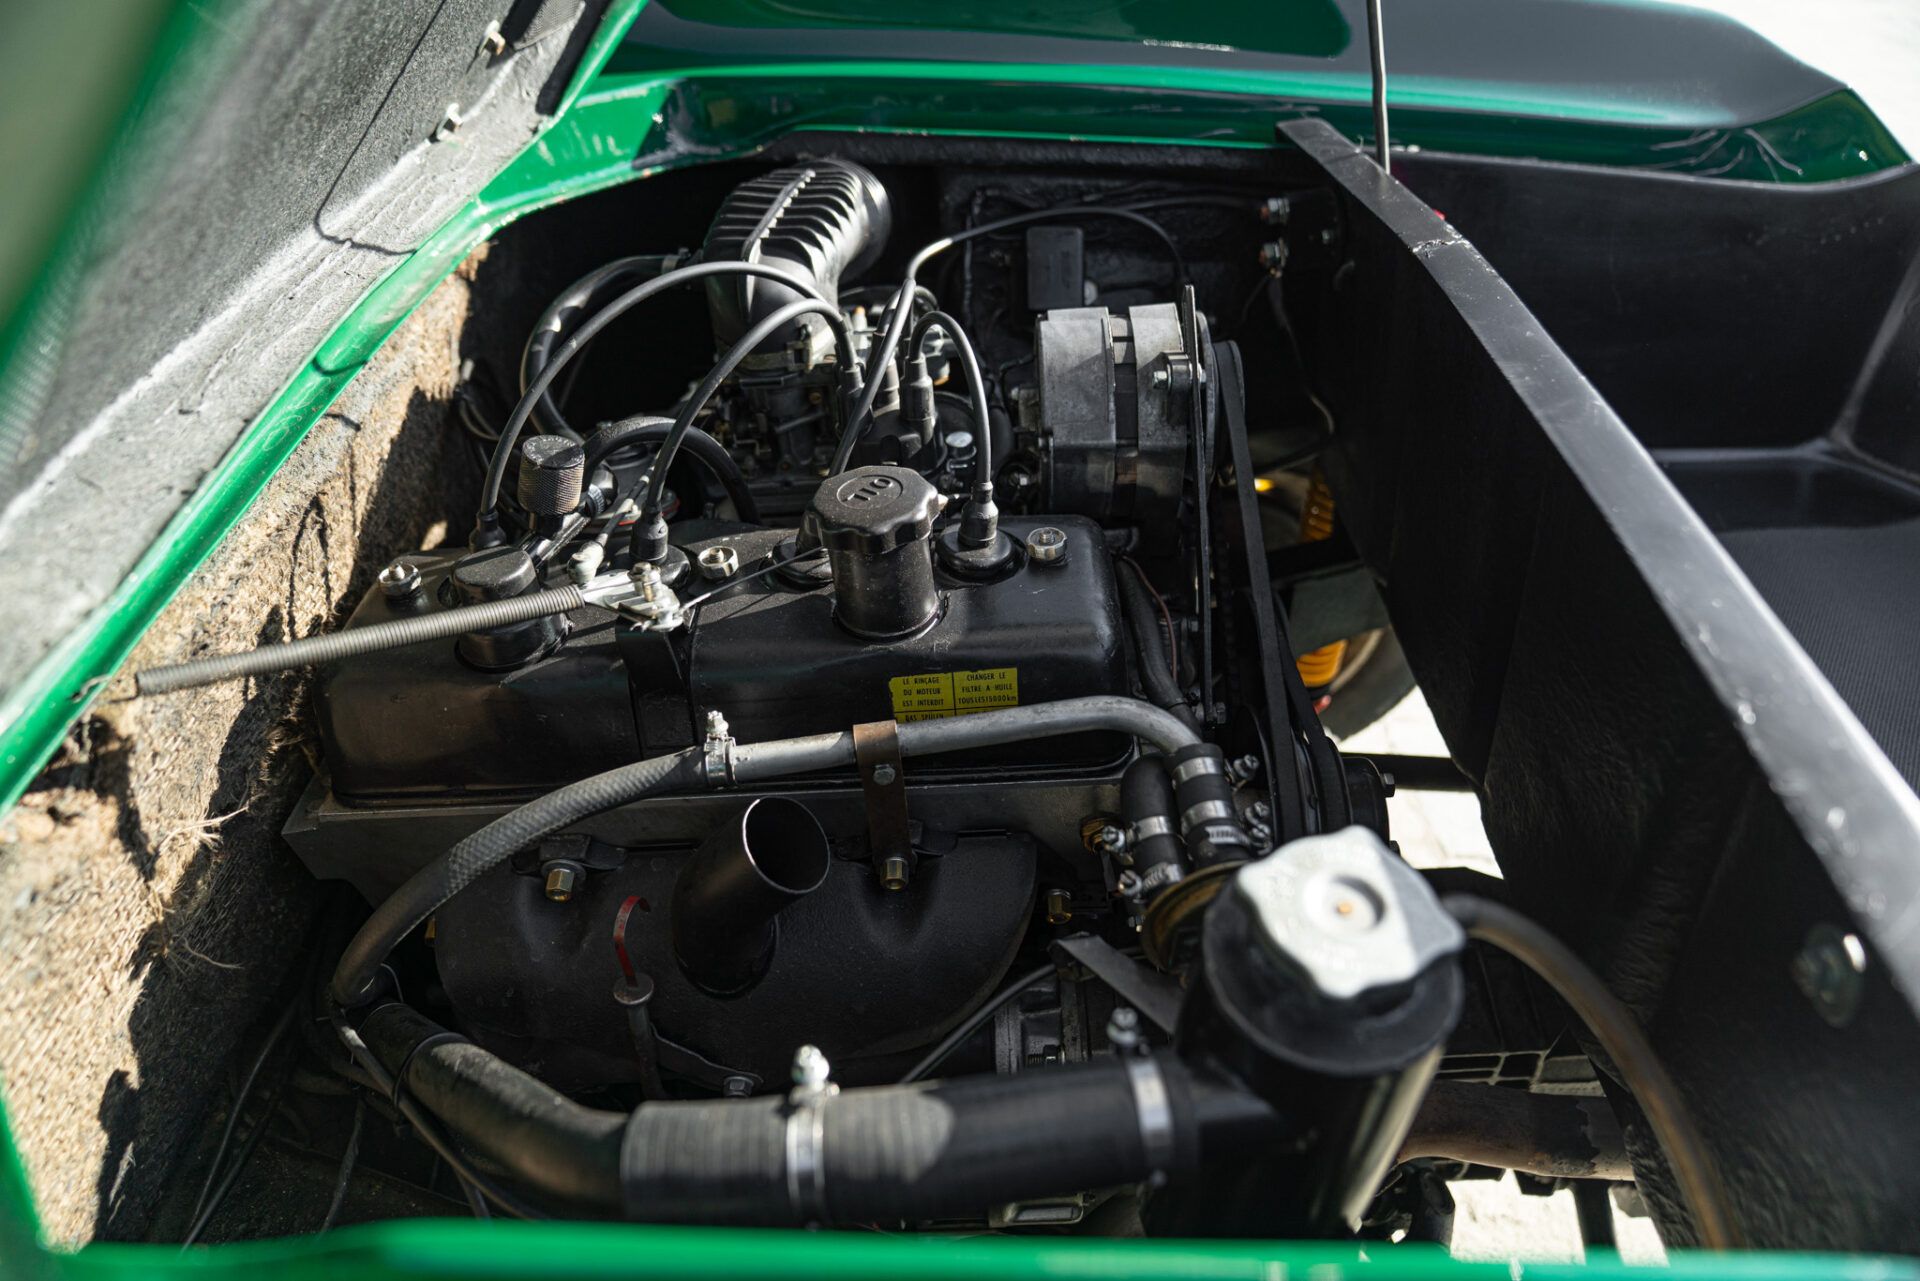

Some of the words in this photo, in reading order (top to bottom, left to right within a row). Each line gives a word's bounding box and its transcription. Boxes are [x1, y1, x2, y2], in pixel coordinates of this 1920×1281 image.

[842, 478, 894, 503] OIL
[966, 673, 995, 681] CHANGER
[916, 687, 941, 695] MOTEUR
[962, 685, 981, 693] FILTRE
[994, 683, 1013, 691] HUILE
[902, 699, 913, 707] EST
[917, 698, 944, 706] INTERDIT
